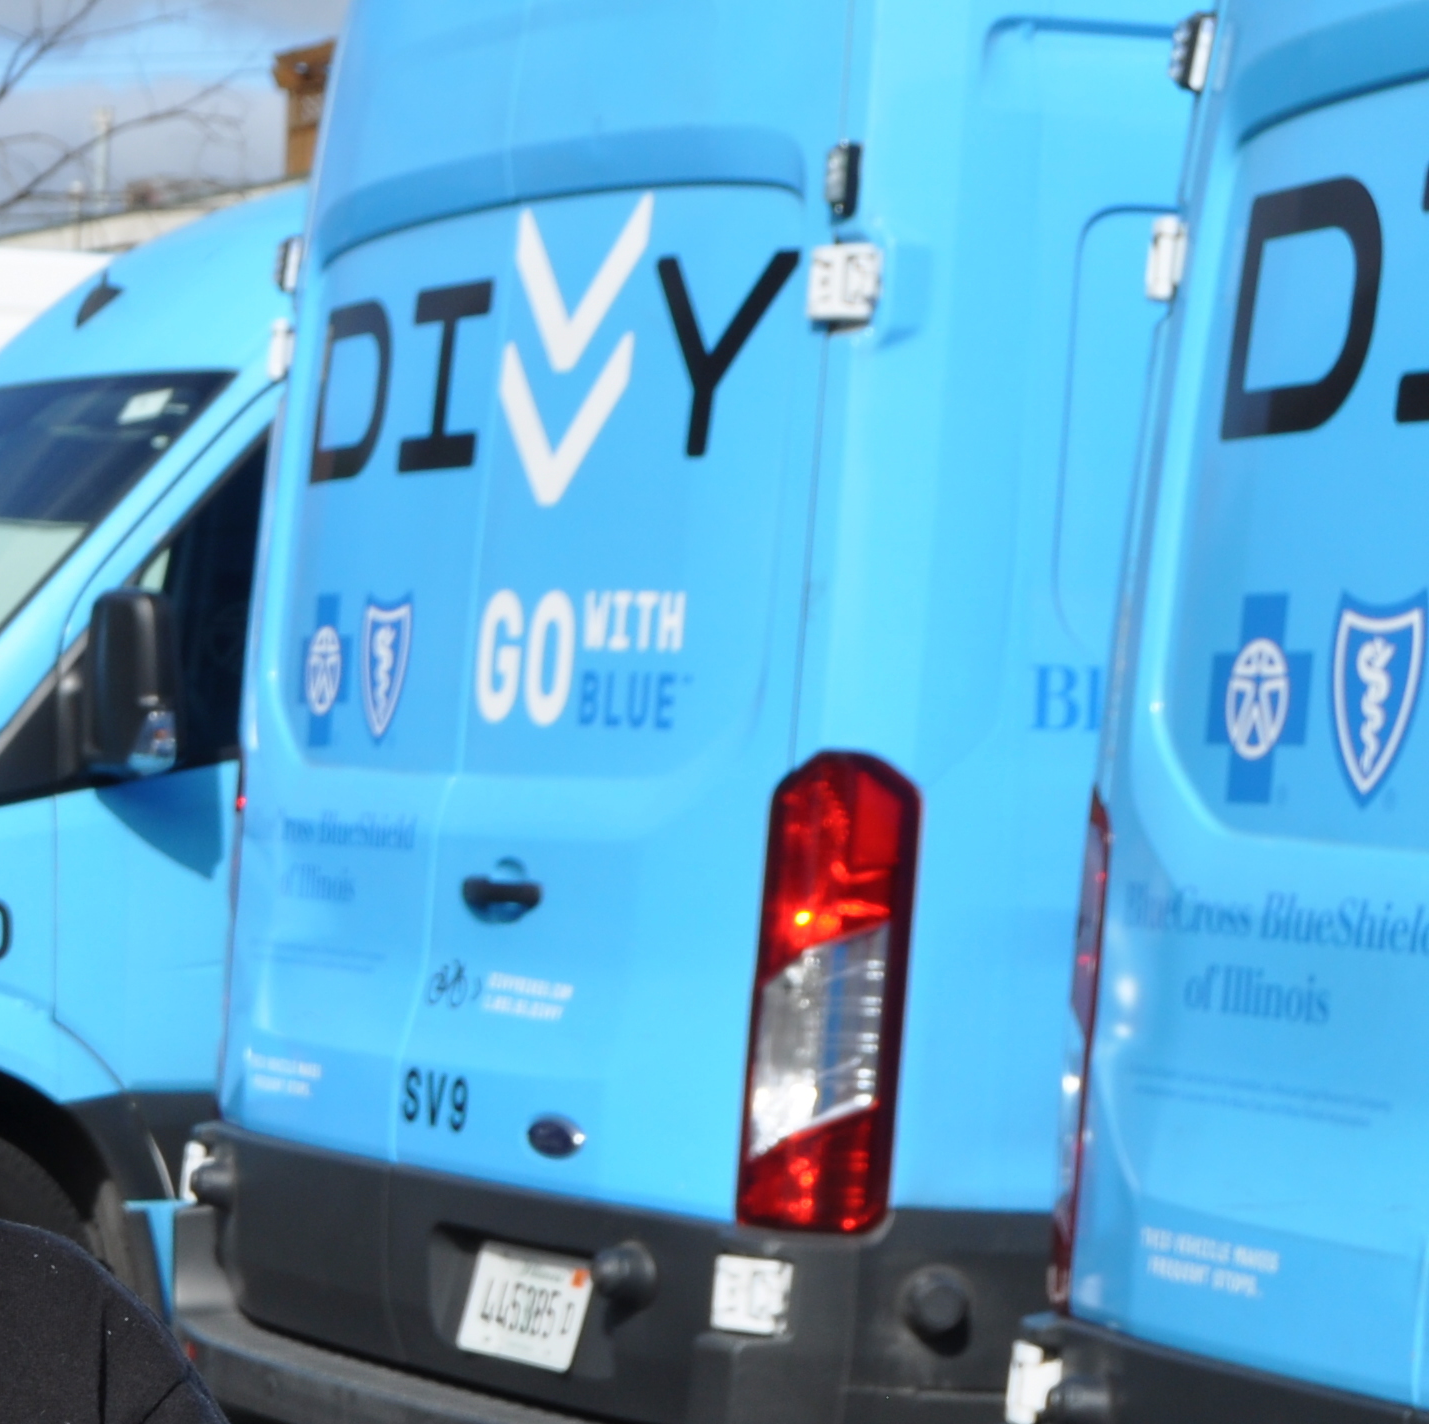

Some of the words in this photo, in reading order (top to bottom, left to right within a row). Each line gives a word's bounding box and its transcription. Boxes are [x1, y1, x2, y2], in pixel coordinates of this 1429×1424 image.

[309, 192, 801, 507] DIVVY
[476, 589, 576, 725] GO
[583, 591, 686, 651] WITH
[578, 670, 678, 730] BLUE
[402, 1067, 469, 1133] SV9
